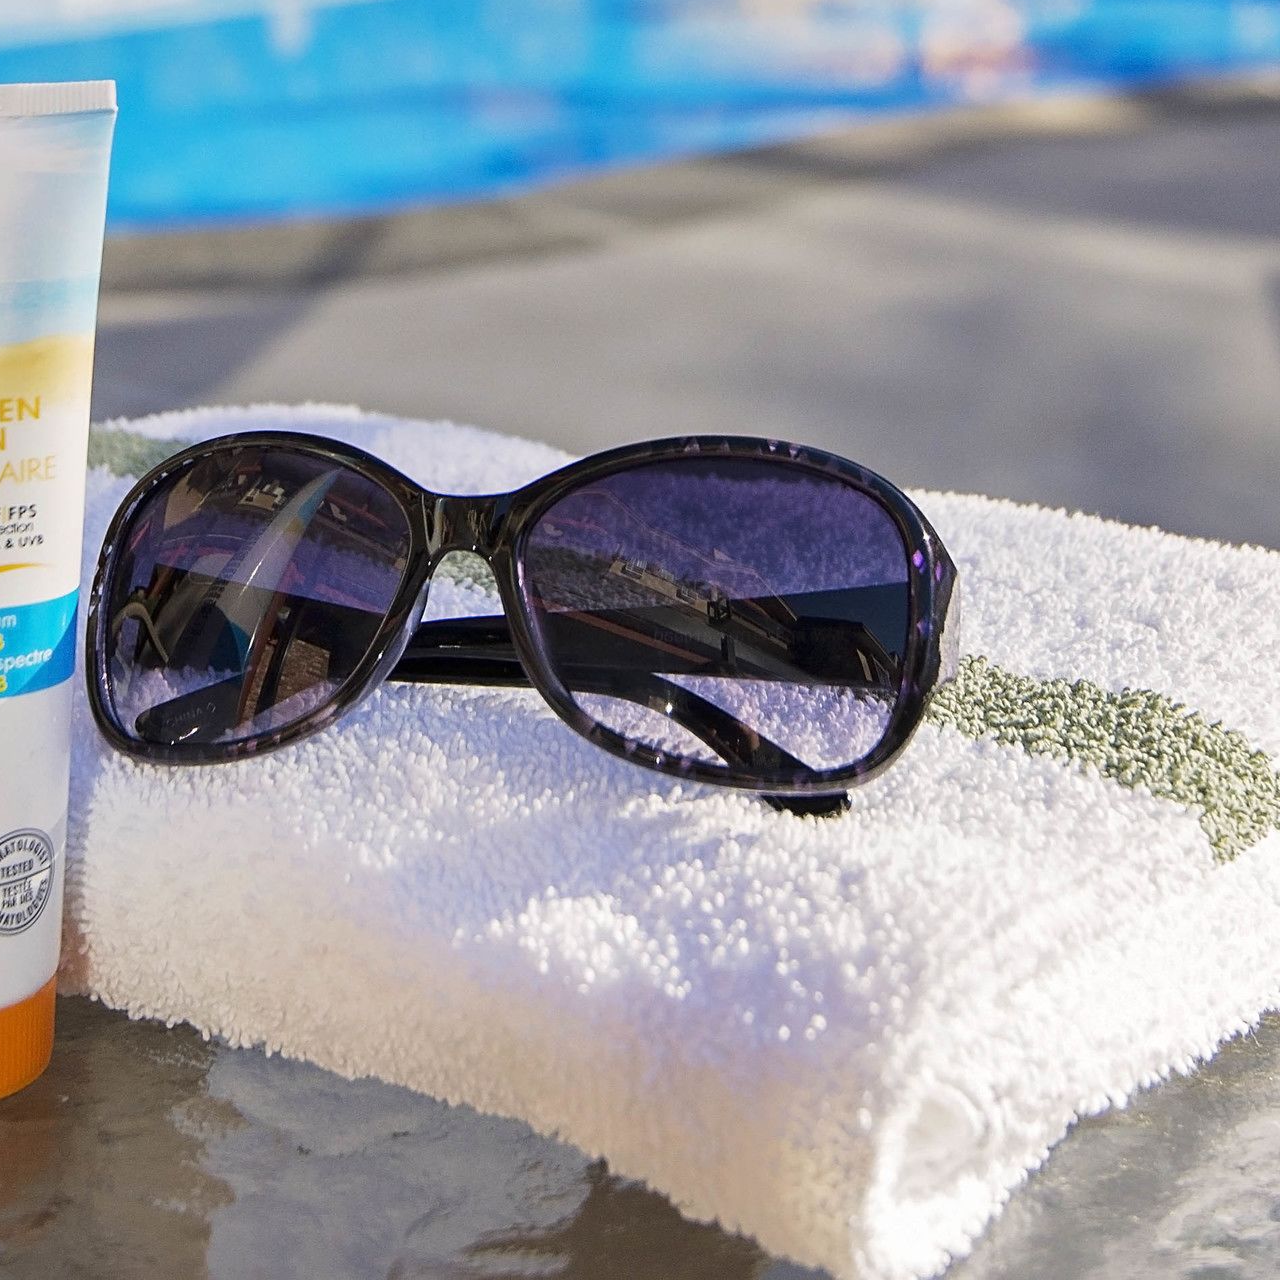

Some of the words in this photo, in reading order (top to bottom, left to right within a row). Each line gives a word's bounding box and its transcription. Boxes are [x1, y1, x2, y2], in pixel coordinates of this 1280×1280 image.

[8, 503, 37, 520] FPS
[18, 533, 44, 548] UVB
[1, 858, 34, 879] TESTED
